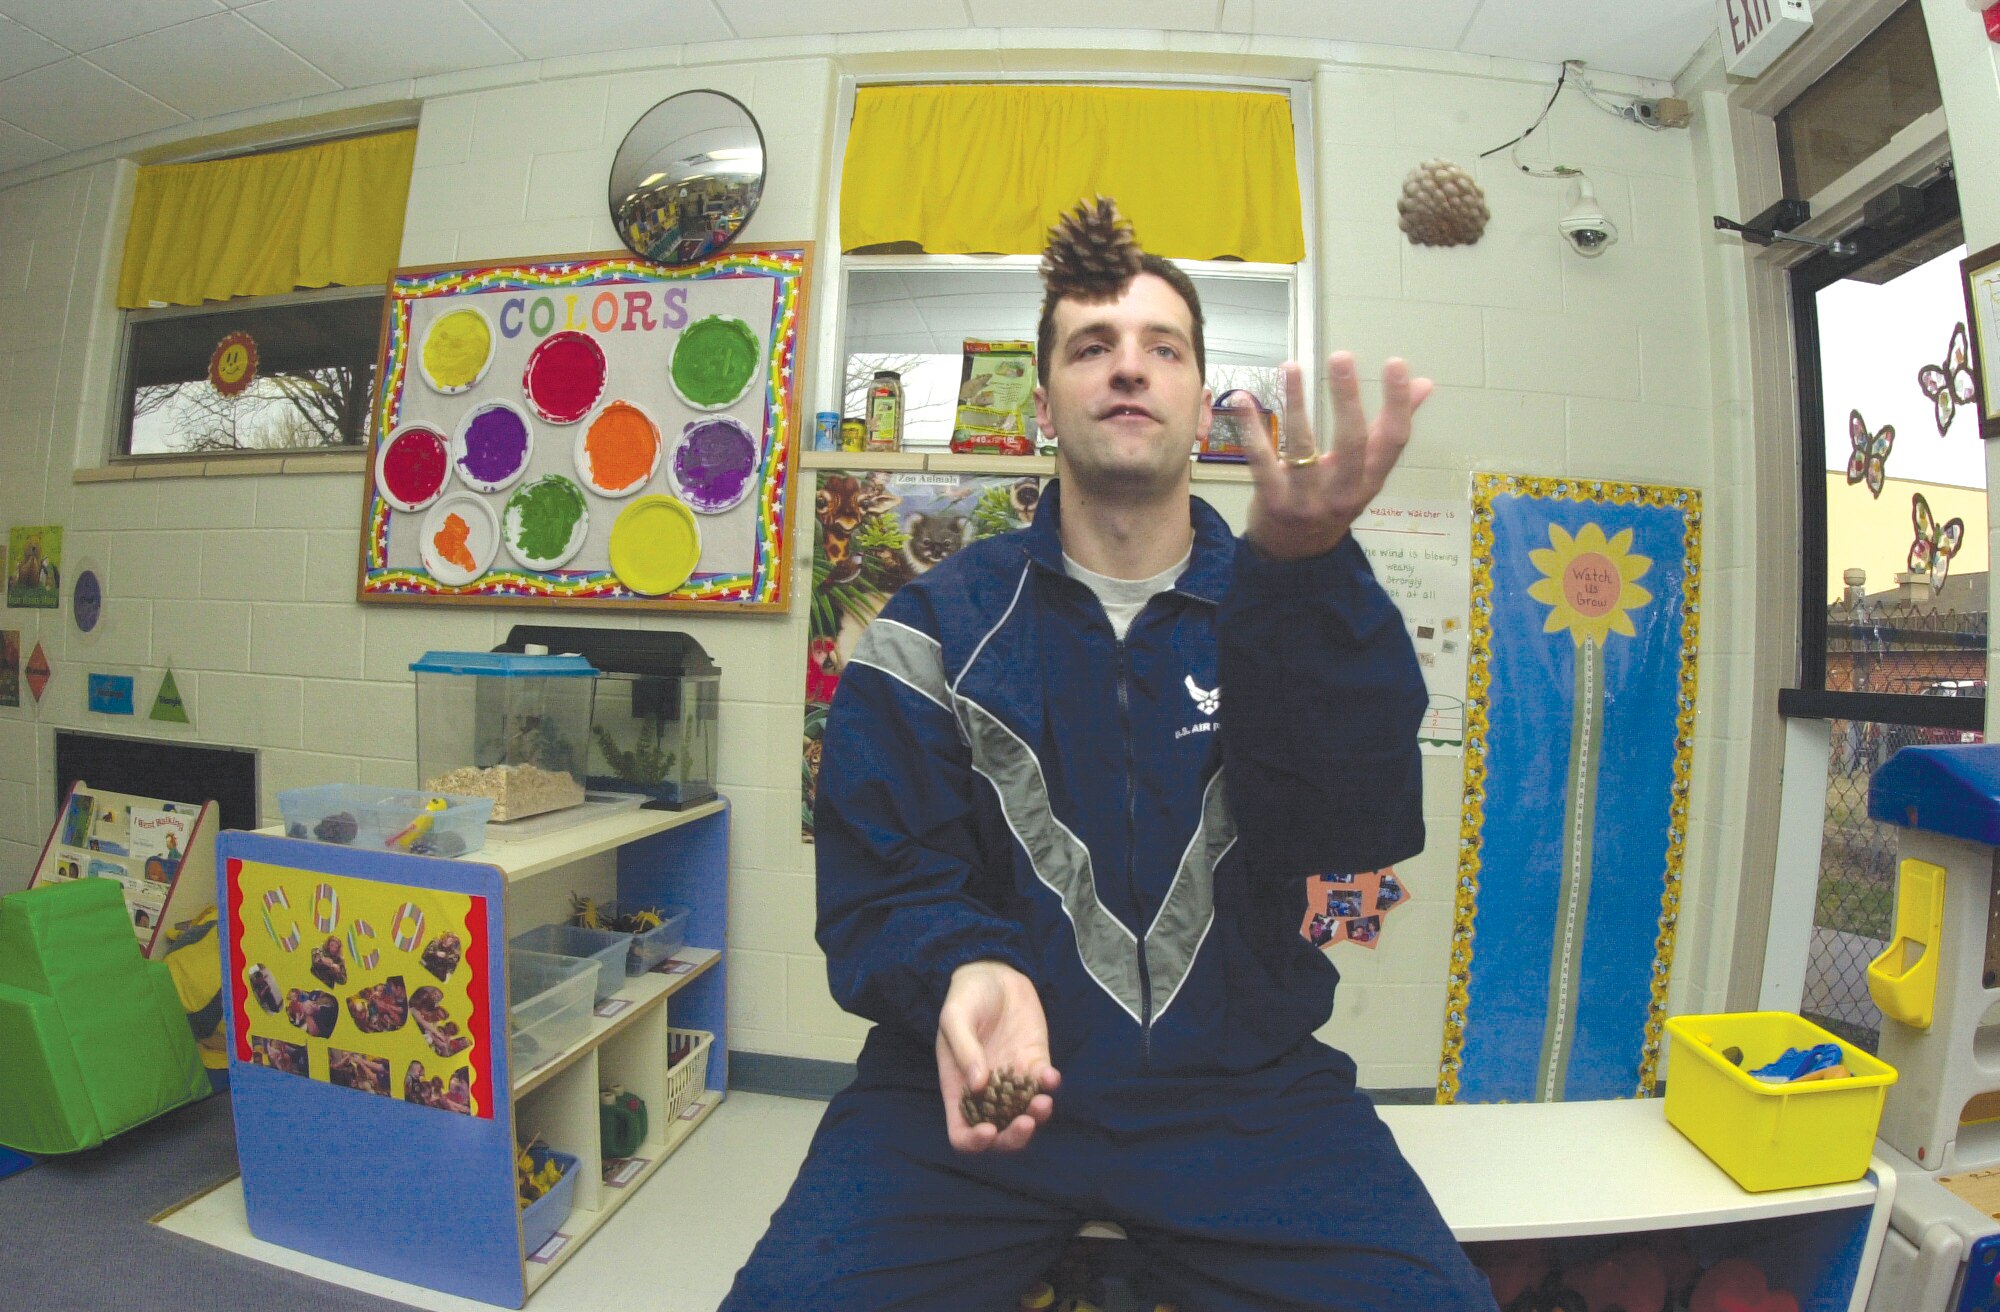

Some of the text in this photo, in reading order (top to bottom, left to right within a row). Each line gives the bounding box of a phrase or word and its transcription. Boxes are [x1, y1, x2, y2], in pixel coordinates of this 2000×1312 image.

[500, 287, 689, 339] COLORS
[898, 473, 957, 484] Zoo Animals
[1369, 507, 1404, 516] weather
[1408, 509, 1441, 518] watcher
[1364, 547, 1458, 566] he wind is blowing
[1573, 567, 1612, 584] Watch
[1406, 590, 1417, 598] at
[1422, 590, 1436, 599] all
[1576, 592, 1607, 607] Grow
[1192, 722, 1211, 733] AIR
